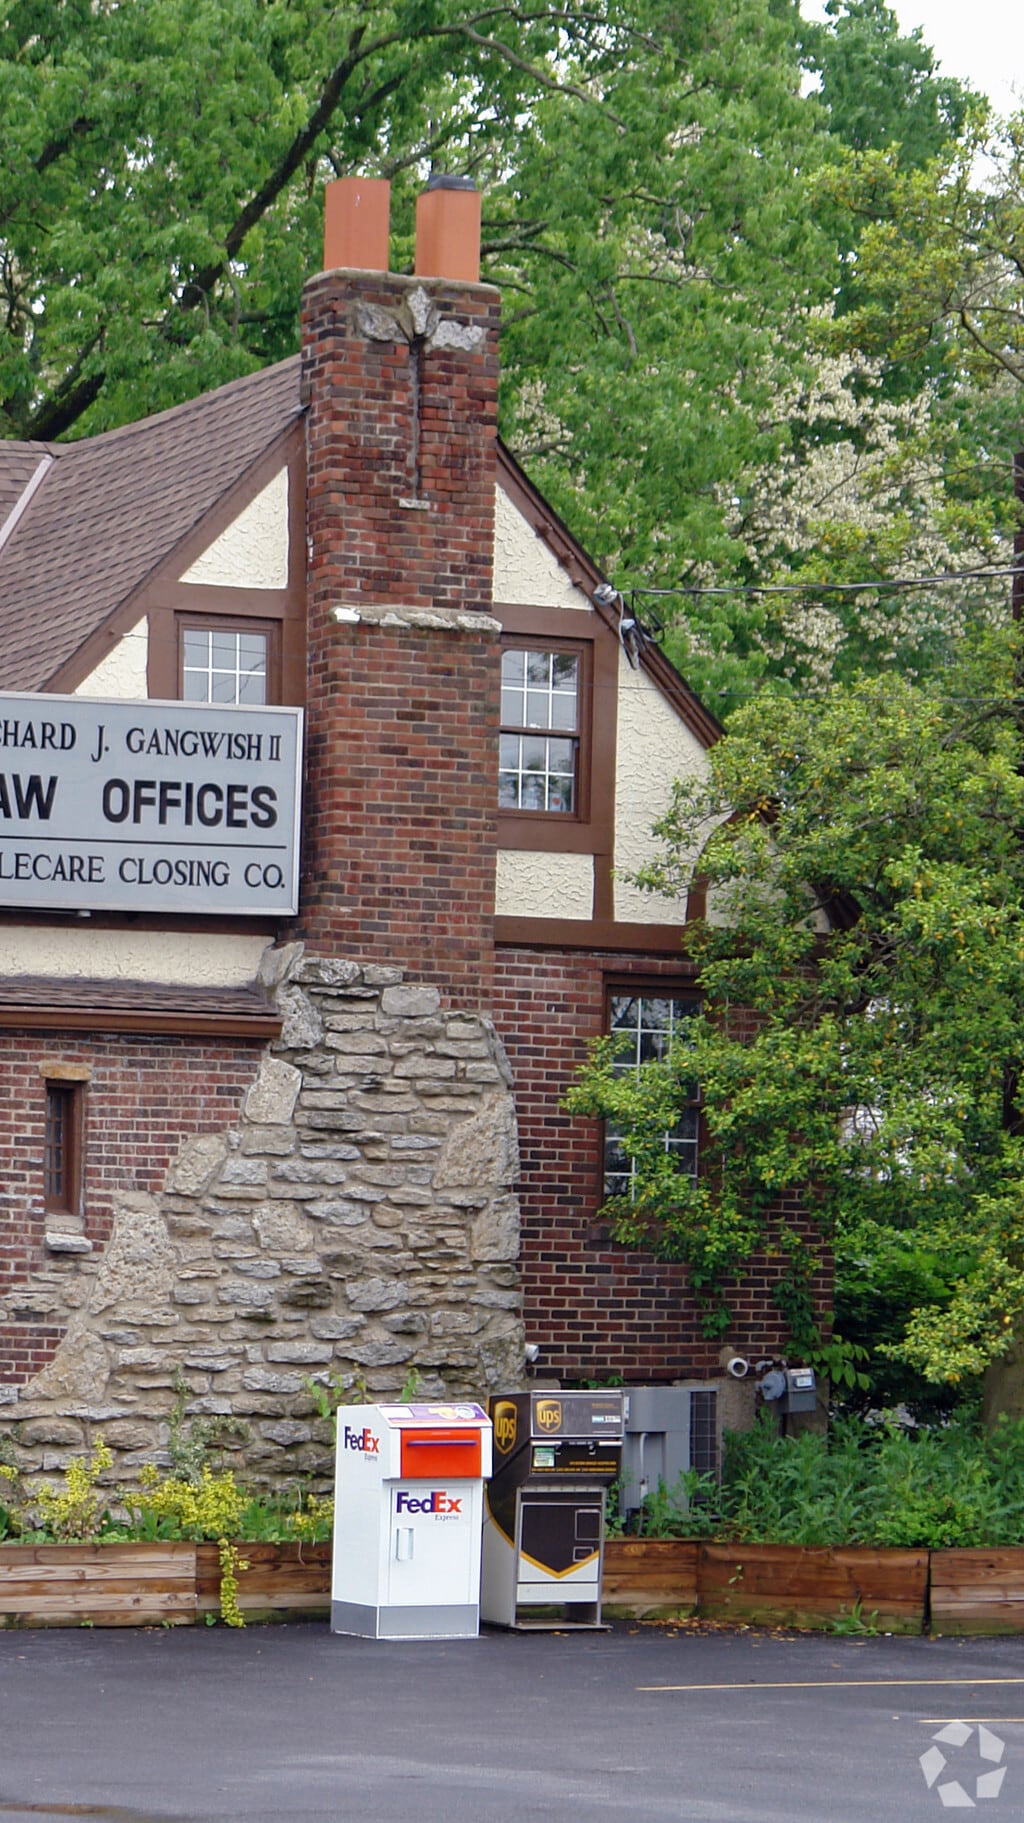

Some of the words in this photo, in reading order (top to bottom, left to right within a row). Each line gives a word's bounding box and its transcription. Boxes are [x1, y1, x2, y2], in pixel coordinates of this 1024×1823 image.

[90, 725, 110, 762] J.
[126, 727, 263, 761] GANGWISH
[268, 734, 282, 761] II
[102, 777, 278, 829] OFFICES
[118, 857, 230, 887] CLOSING
[244, 863, 286, 889] CO.
[496, 1417, 515, 1446] ups
[539, 1410, 560, 1428] ups
[344, 1425, 380, 1453] FedEx
[396, 1491, 463, 1513] FedEx
